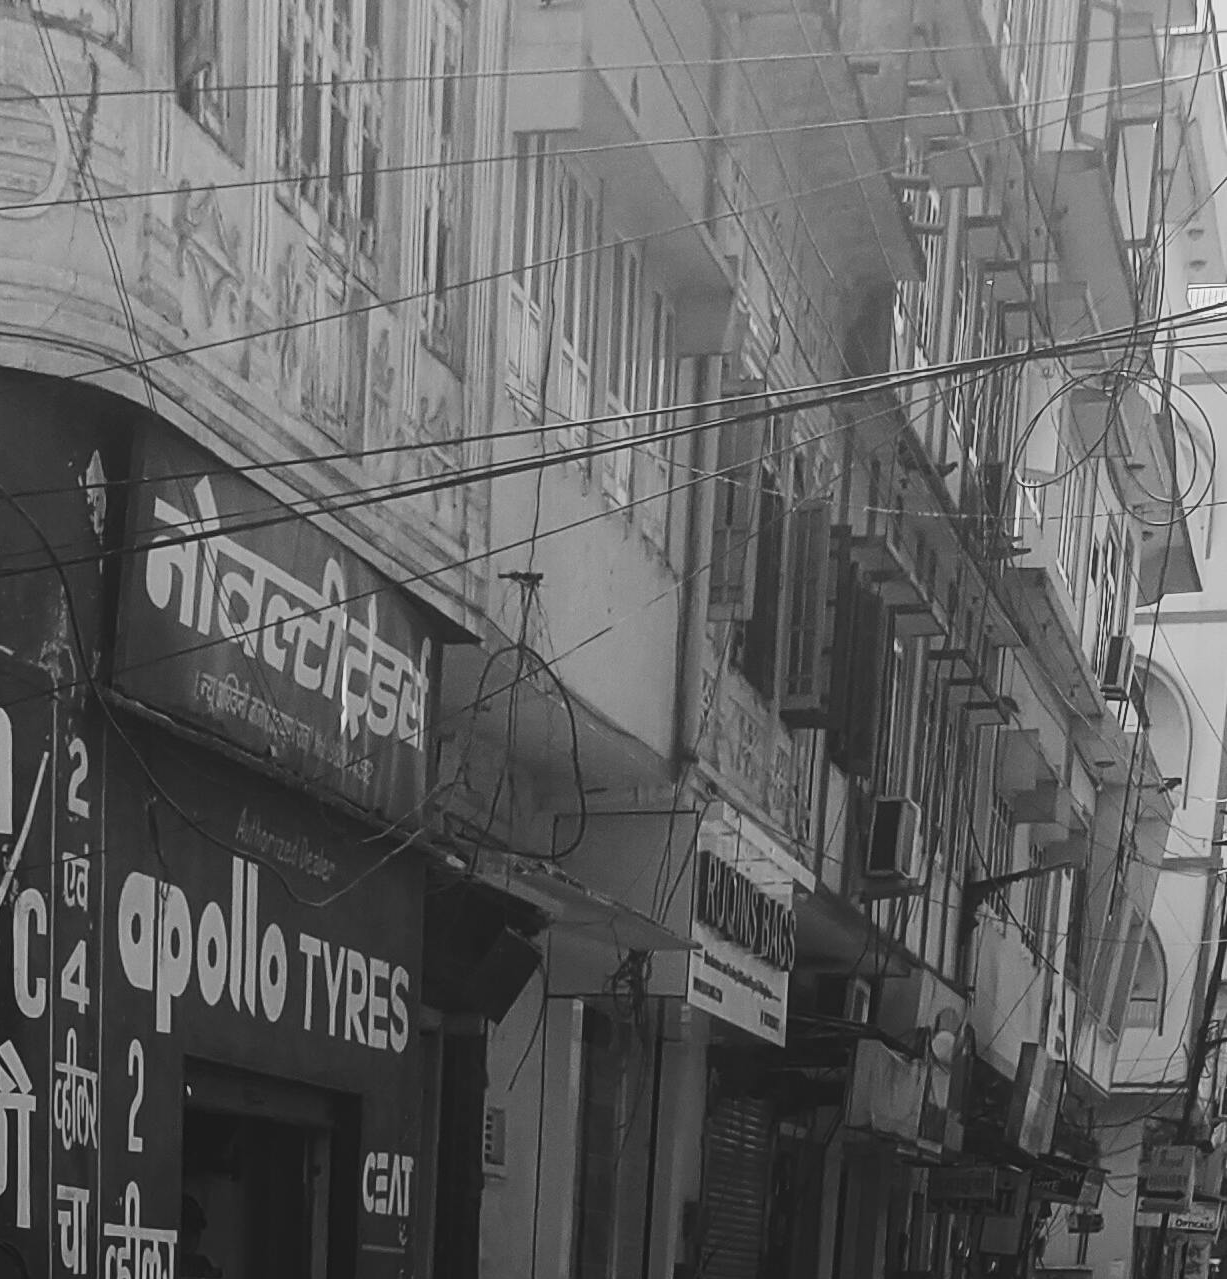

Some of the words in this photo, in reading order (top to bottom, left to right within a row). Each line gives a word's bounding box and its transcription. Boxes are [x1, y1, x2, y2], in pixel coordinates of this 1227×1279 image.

[118, 855, 288, 1035] apollo
[298, 932, 411, 1055] TYRES
[760, 894, 797, 973] BAGS
[60, 939, 92, 1015] 4
[127, 1037, 145, 1153] 2
[361, 1151, 415, 1218] CEAT
